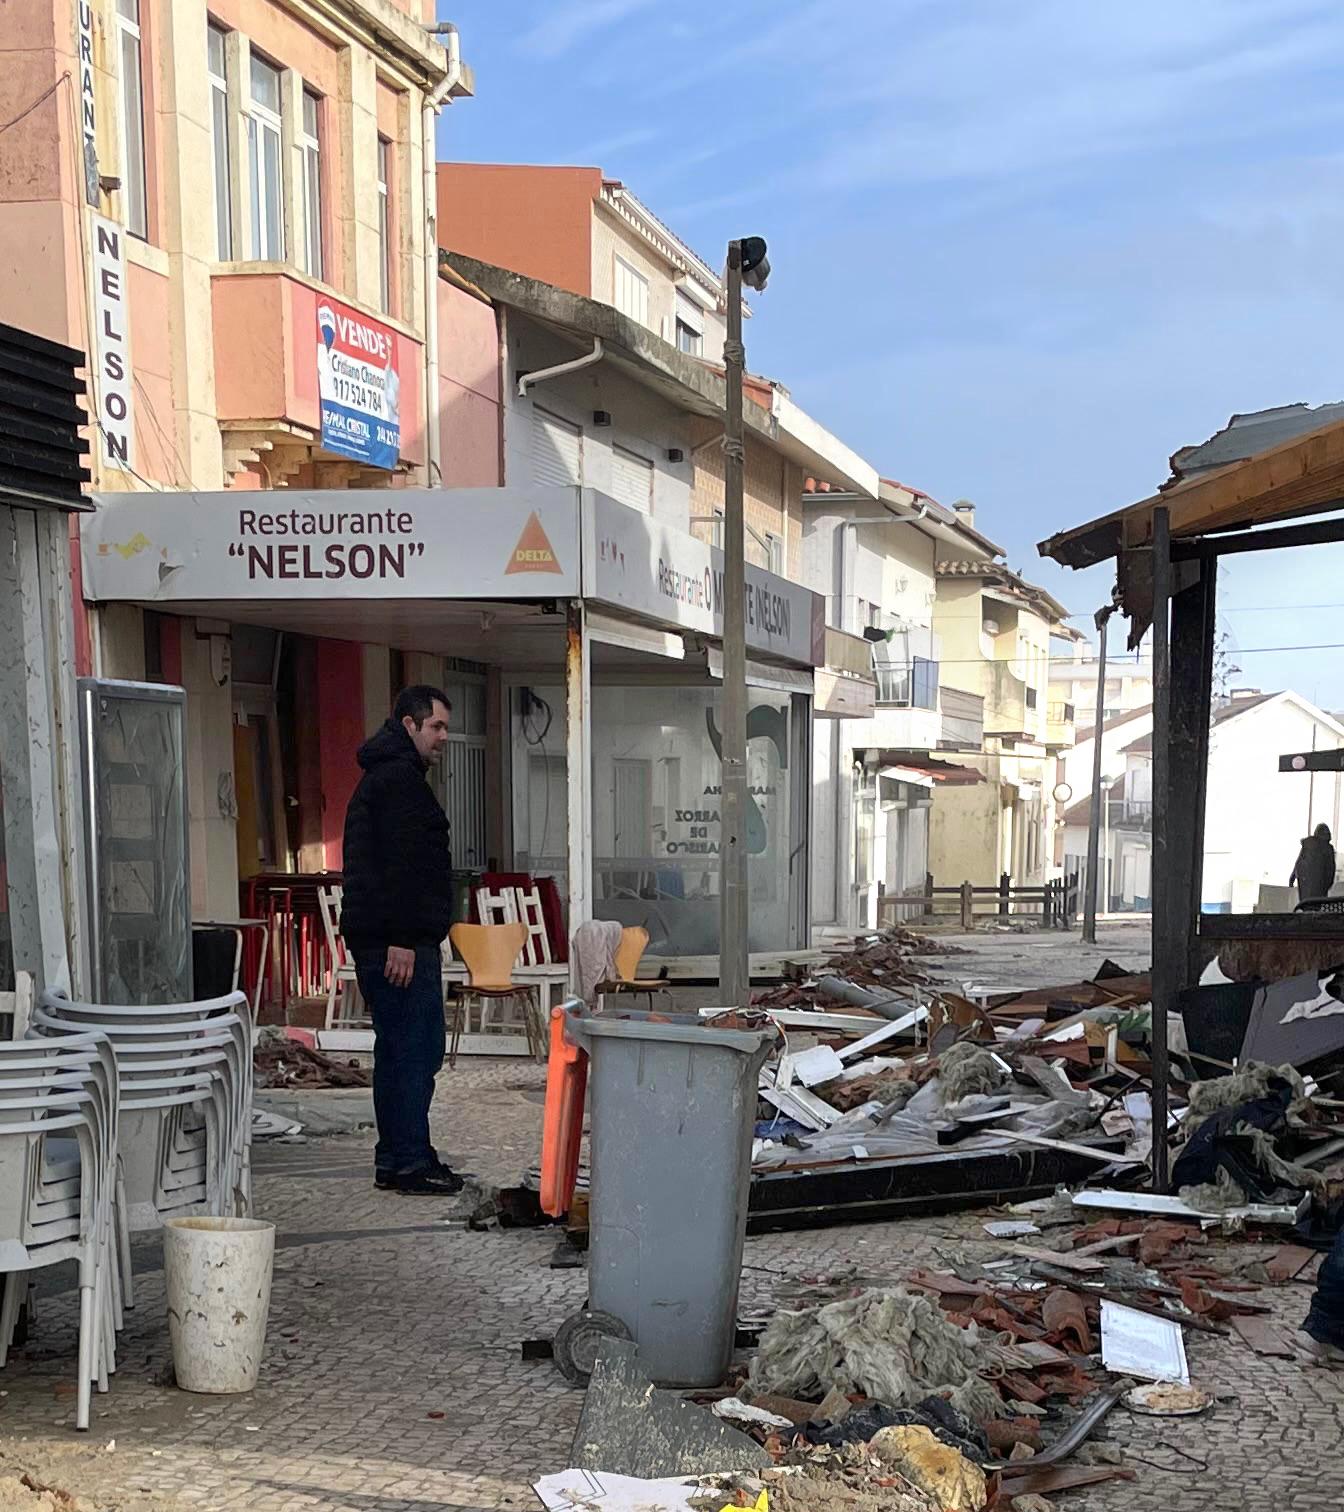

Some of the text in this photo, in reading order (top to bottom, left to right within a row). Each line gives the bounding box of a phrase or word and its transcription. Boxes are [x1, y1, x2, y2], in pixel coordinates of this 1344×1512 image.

[97, 225, 127, 462] NELSON
[336, 313, 387, 360] VENDE
[239, 508, 413, 535] Restaurante
[516, 549, 553, 561] DELTA
